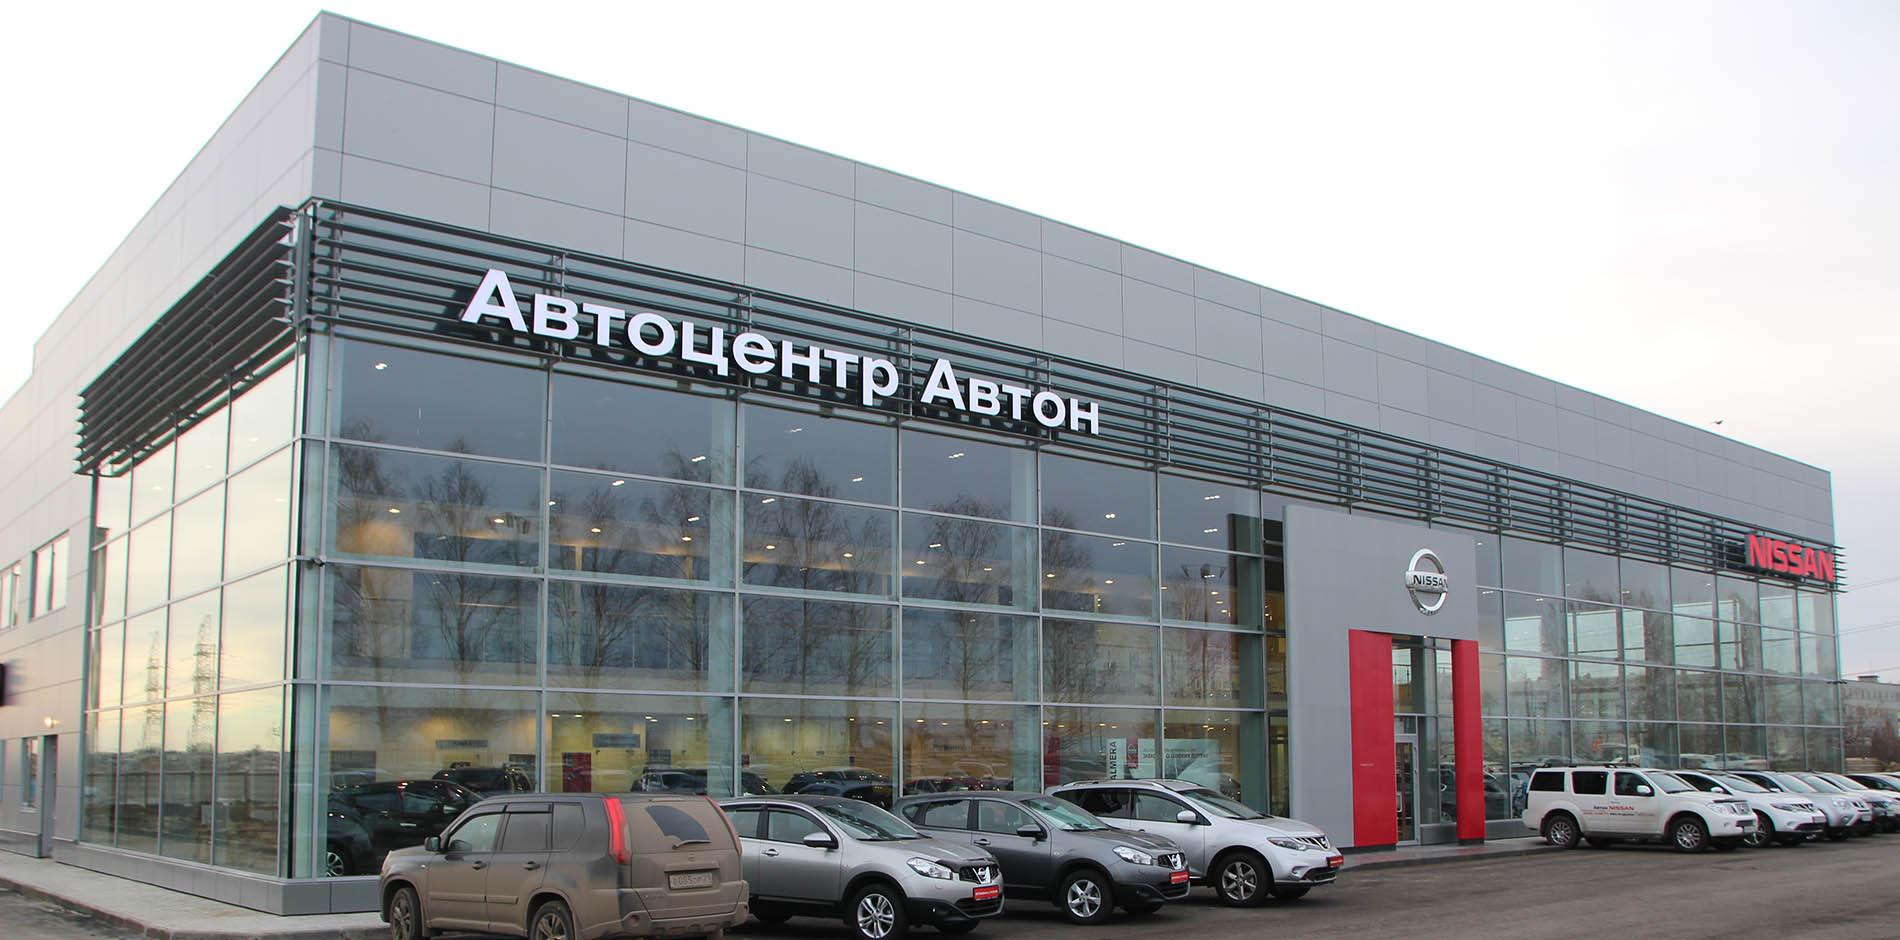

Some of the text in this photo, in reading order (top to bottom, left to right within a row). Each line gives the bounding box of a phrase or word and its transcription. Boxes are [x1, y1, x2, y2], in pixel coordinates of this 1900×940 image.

[460, 268, 1100, 436] Автоцентр Автон
[1749, 533, 1835, 582] NISSAN
[1109, 741, 1117, 780] ALMERA
